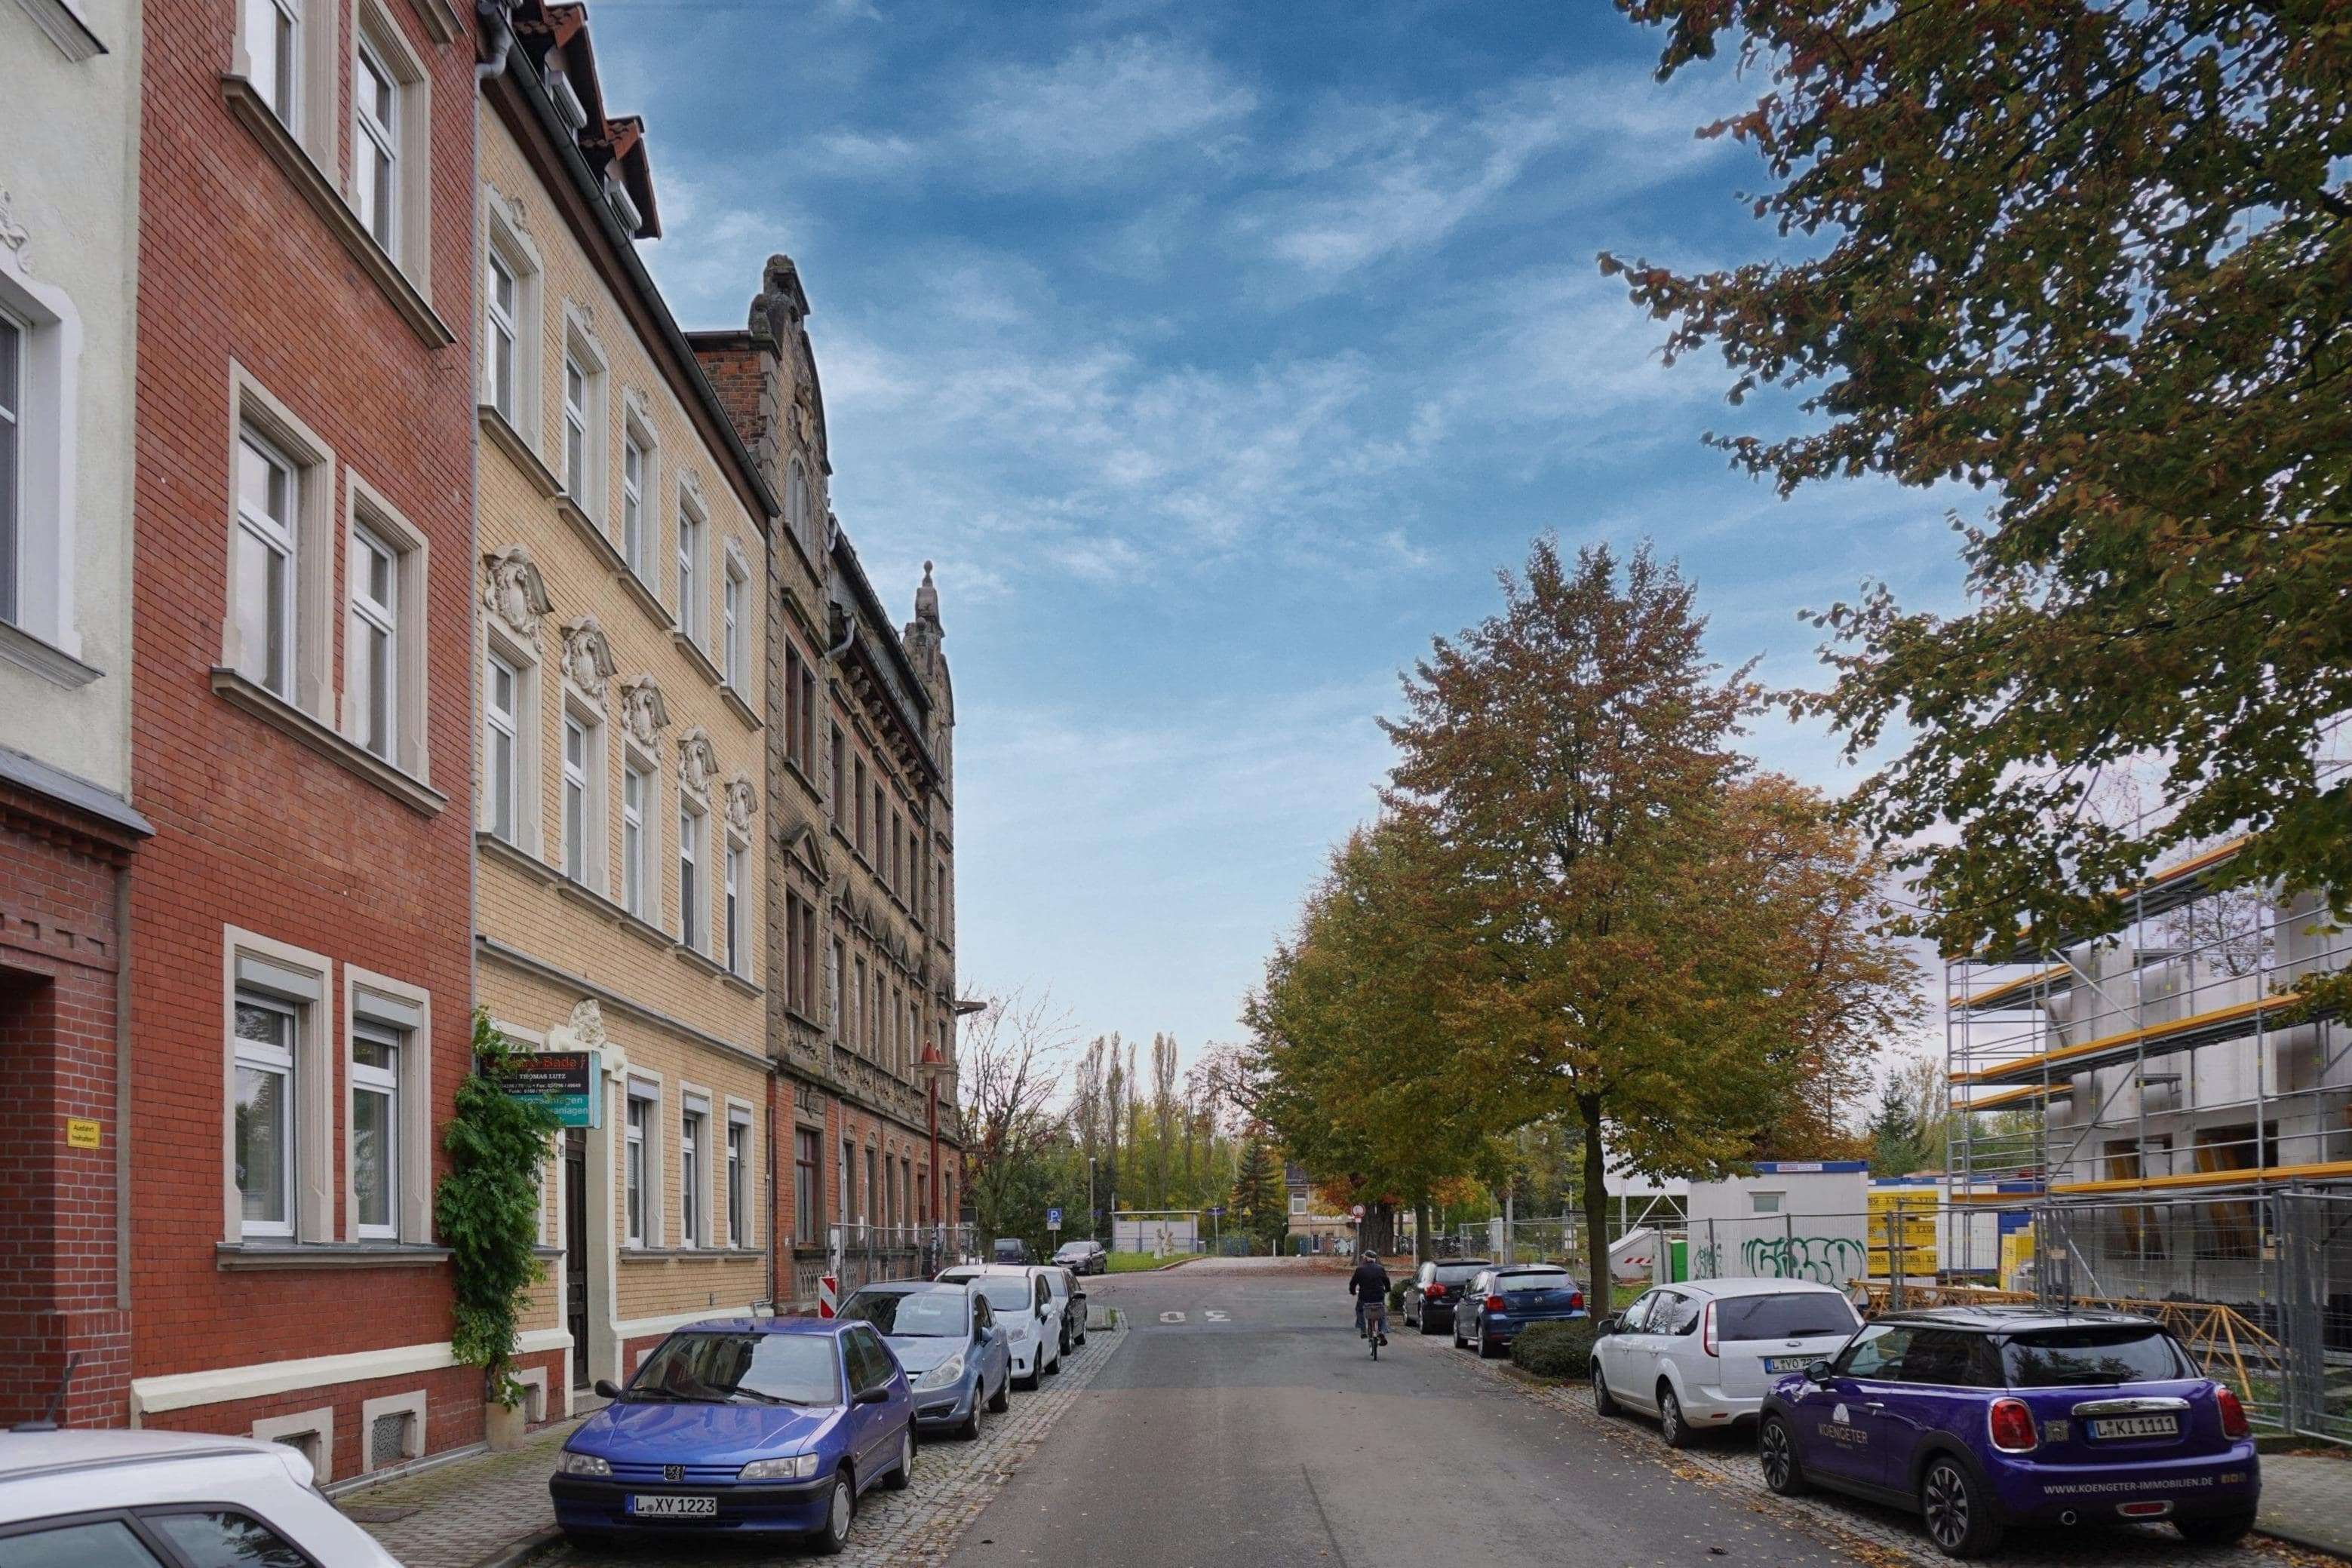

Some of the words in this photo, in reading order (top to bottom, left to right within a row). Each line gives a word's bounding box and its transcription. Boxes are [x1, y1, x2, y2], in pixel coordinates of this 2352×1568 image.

[1817, 1422, 1868, 1444] KOENGETER
[2096, 1422, 2108, 1437] L
[2117, 1420, 2137, 1435] KI
[2139, 1417, 2177, 1434] 1111
[2043, 1476, 2214, 1494] WWW.KOENGETER-IMMOBILIEN.DE
[635, 1497, 645, 1511] L
[655, 1498, 674, 1512] XY
[677, 1499, 715, 1513] 1223
